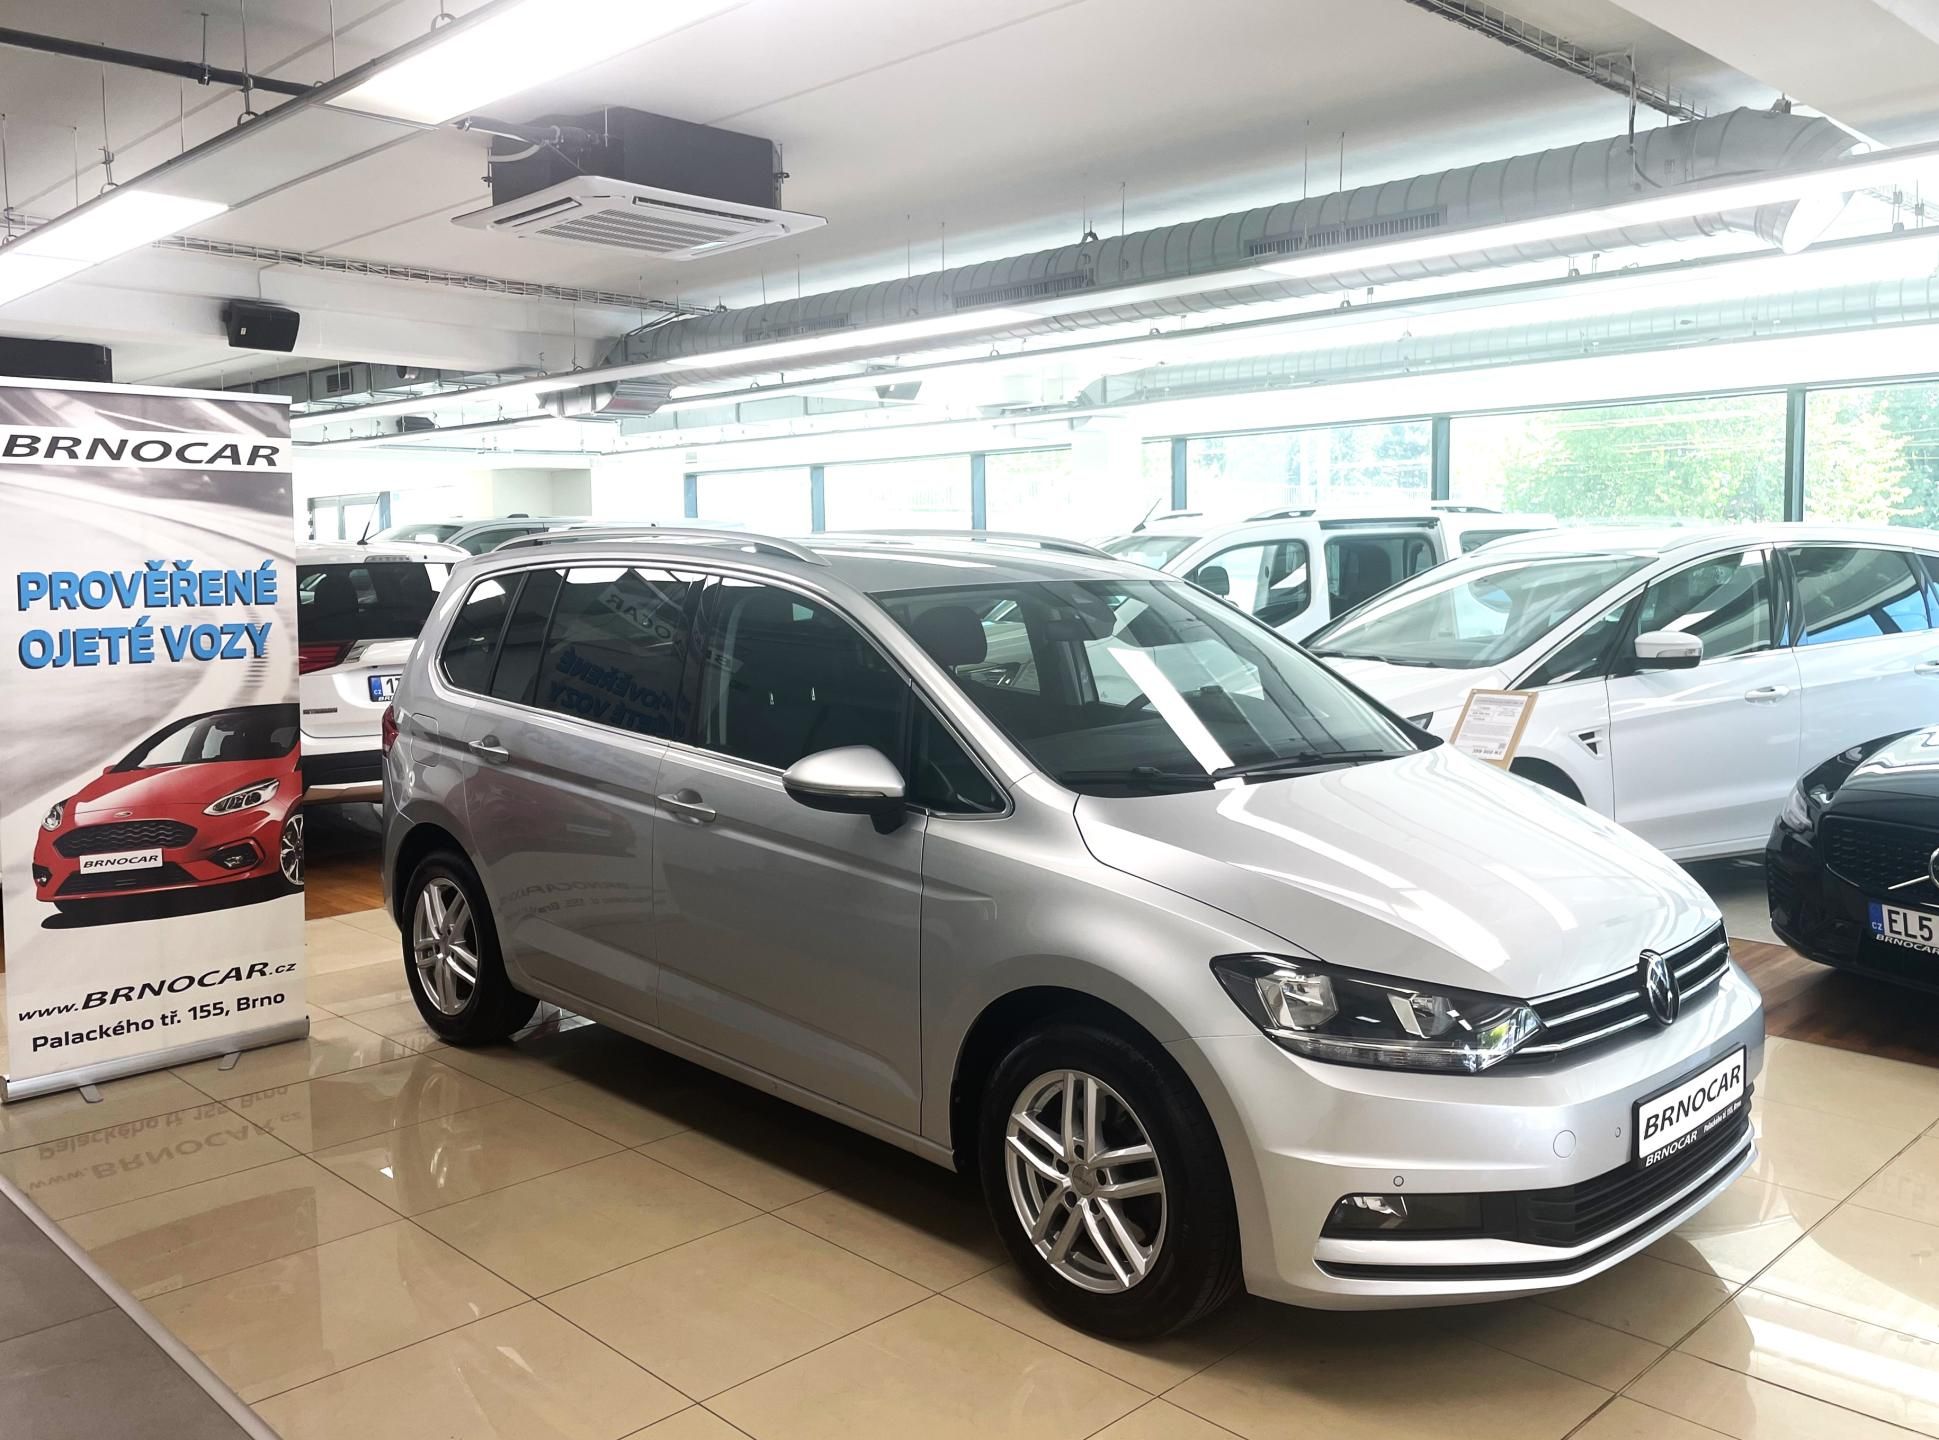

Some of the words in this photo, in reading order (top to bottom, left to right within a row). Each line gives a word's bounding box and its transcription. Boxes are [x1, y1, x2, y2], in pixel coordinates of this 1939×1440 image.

[2, 434, 280, 466] BRNOCAR
[17, 559, 278, 611] PROVĚŘENÉ
[18, 615, 155, 669] OJETÉ
[160, 622, 273, 662] VOZY
[83, 855, 159, 869] BRNOCAR
[1871, 921, 1883, 931] CZ
[18, 962, 297, 1022] www.BRNOCAR.cz
[32, 1018, 155, 1052] Palackého
[160, 1009, 182, 1026] tř.
[187, 1002, 230, 1021] 155,
[236, 992, 285, 1013] Brno
[1643, 1065, 1741, 1140] BRNOCAR
[1645, 1130, 1698, 1168] BRNOCAR
